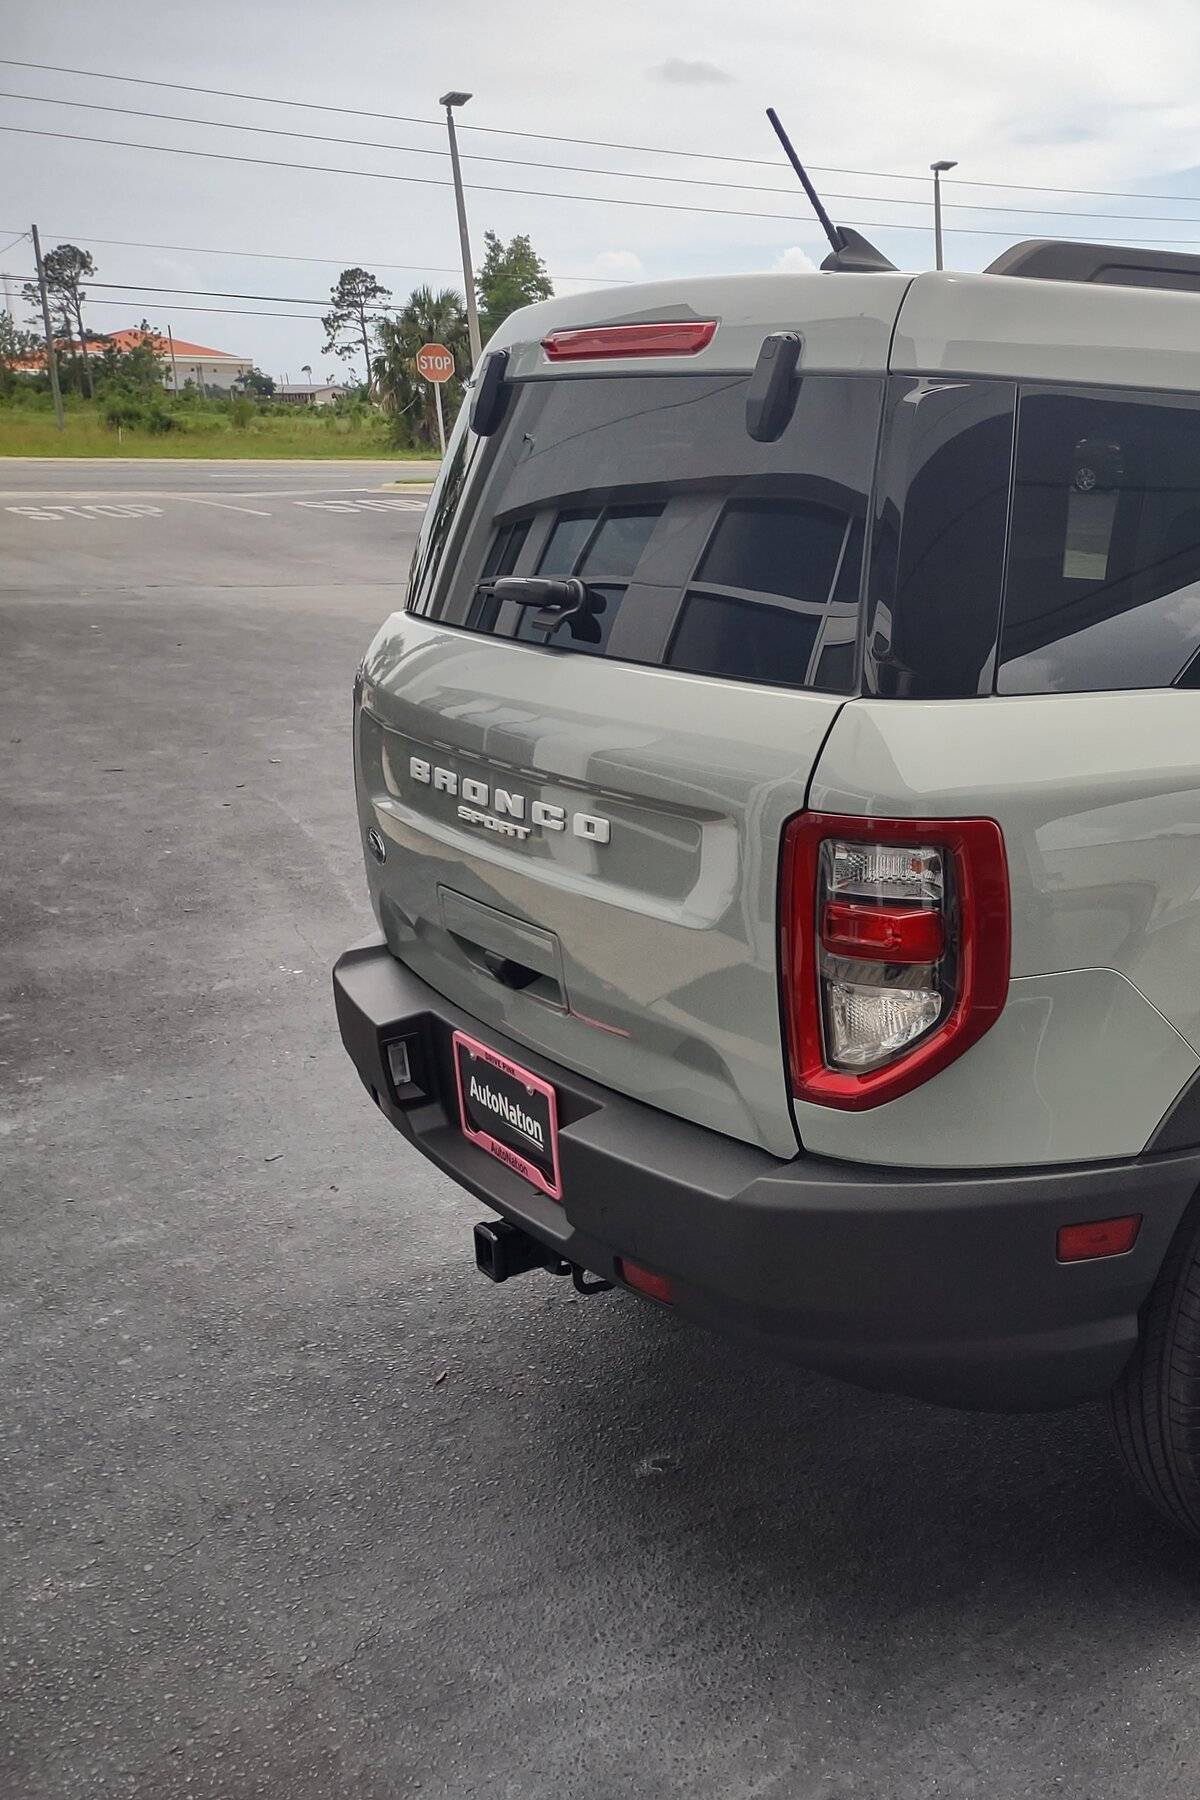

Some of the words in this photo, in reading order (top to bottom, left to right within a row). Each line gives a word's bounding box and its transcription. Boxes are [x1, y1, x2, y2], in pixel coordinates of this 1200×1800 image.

[420, 356, 451, 370] STOP
[4, 504, 164, 520] STOP
[292, 499, 428, 513] STOP
[410, 756, 611, 844] BRONCO
[458, 805, 533, 840] SPORT
[485, 1052, 502, 1068] DRIVE
[470, 1075, 544, 1142] AutoNation
[490, 1141, 529, 1176] AutoNation
